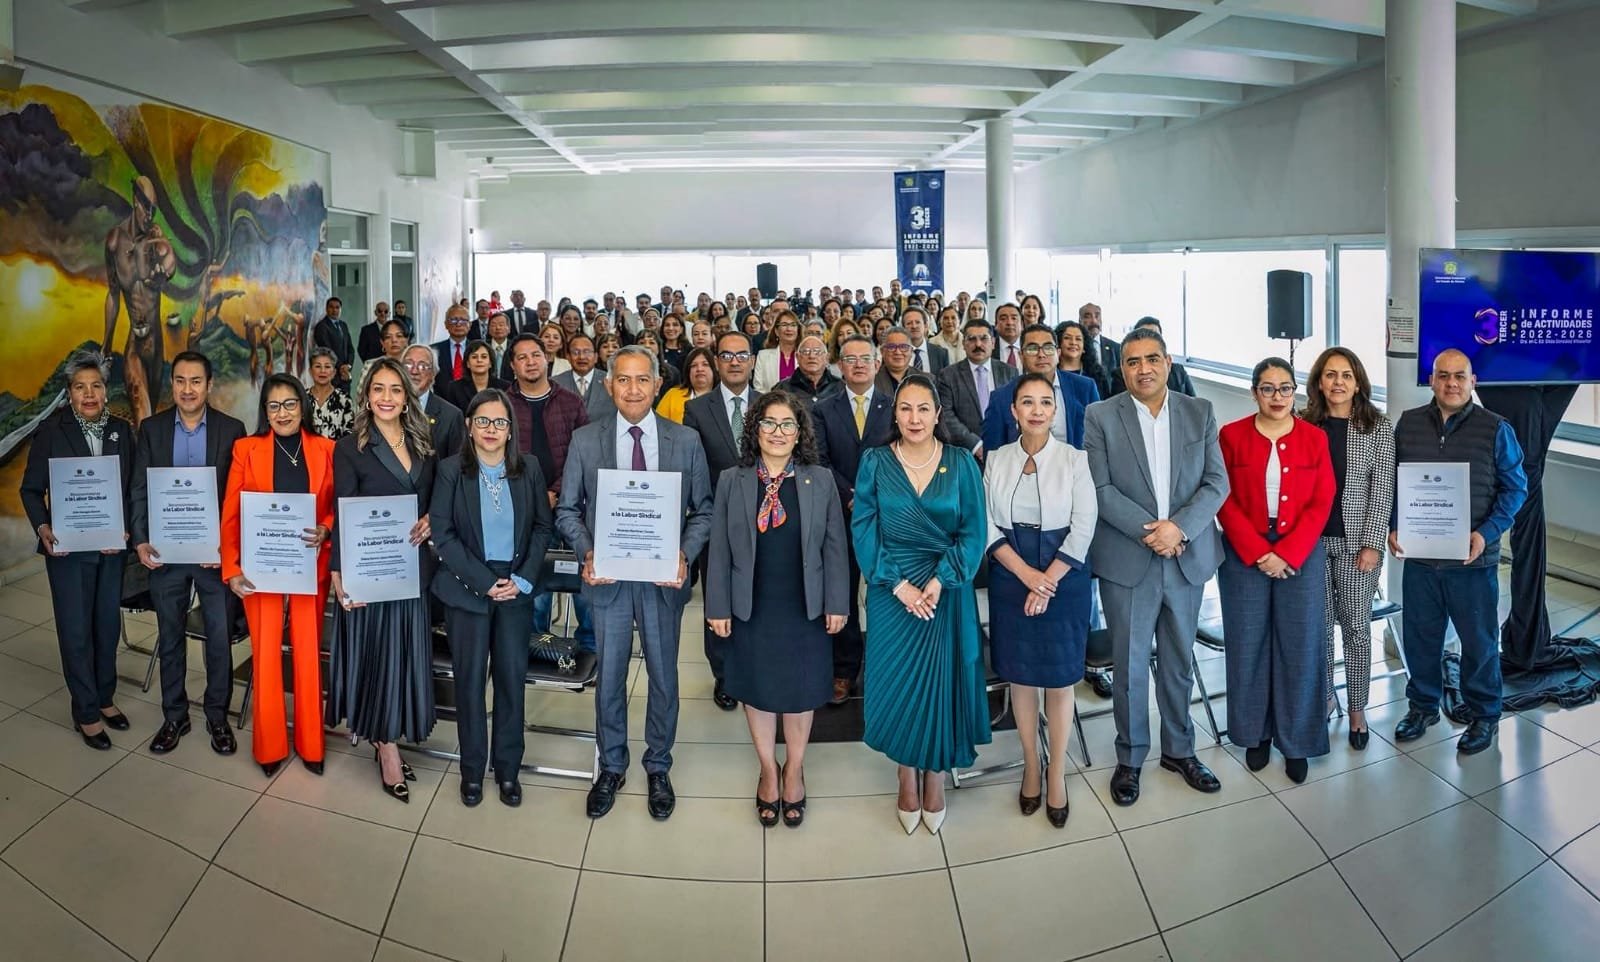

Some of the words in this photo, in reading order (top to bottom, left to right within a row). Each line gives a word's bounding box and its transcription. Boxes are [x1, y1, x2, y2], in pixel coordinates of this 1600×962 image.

[911, 206, 925, 230] 3
[1521, 308, 1593, 319] INFORME
[1499, 310, 1508, 344] TERCER
[1521, 319, 1533, 328] de
[1534, 319, 1593, 328] ACTIVIDADES
